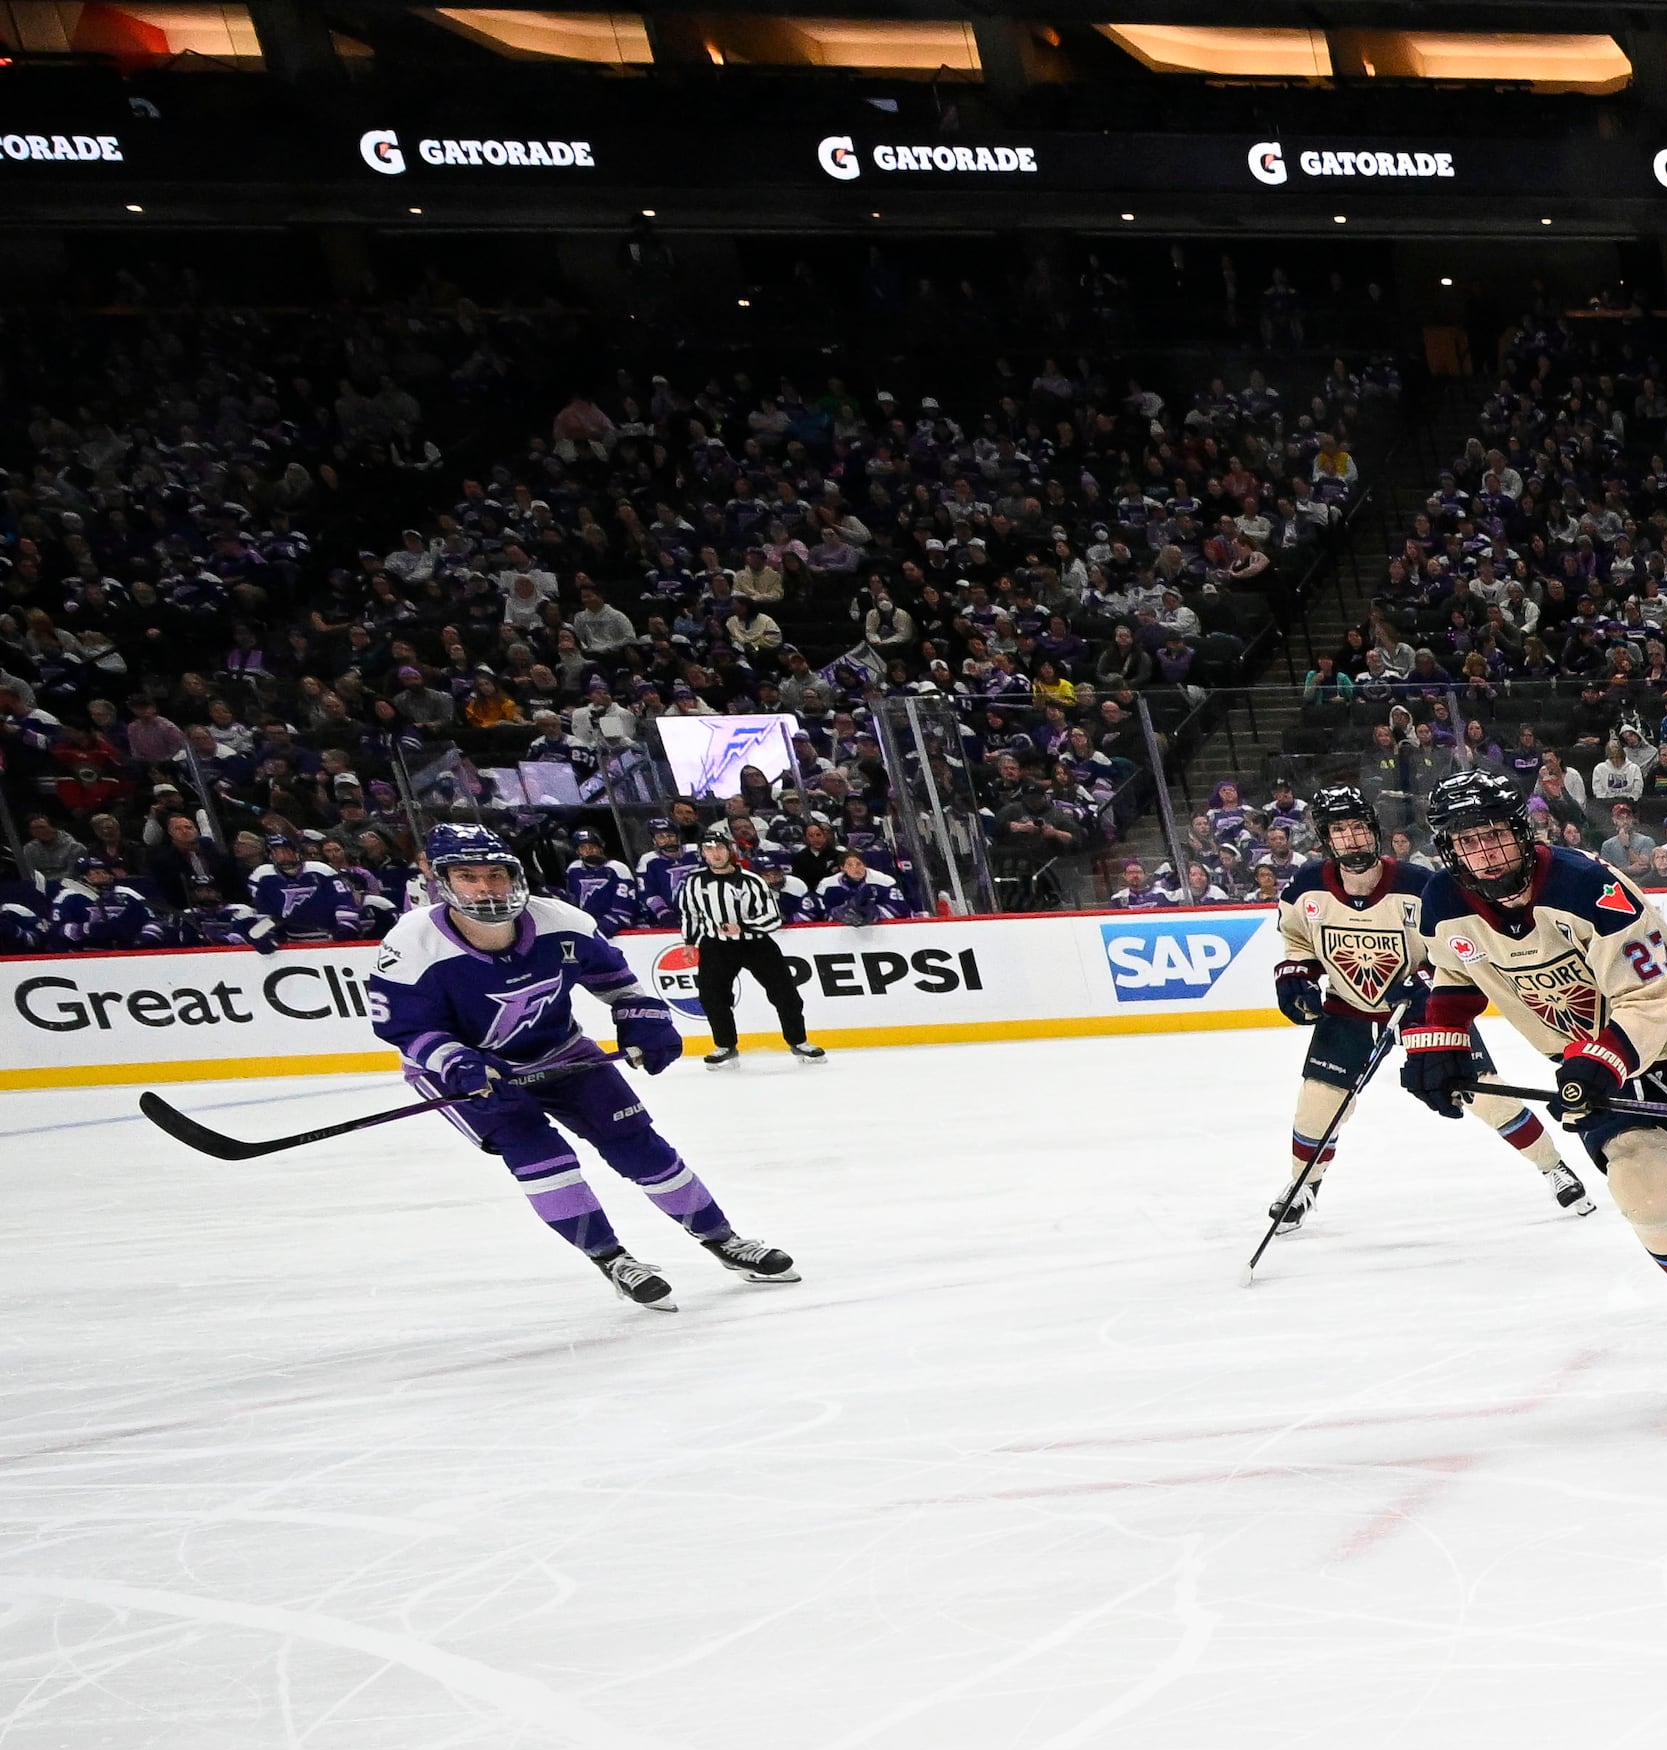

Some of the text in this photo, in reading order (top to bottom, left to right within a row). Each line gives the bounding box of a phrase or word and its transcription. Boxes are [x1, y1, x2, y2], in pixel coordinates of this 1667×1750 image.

[0, 134, 124, 162] ORADE
[418, 139, 595, 167] GATORADE
[873, 144, 1038, 172] GATORADE
[1299, 150, 1455, 177] GATORADE
[783, 947, 984, 999] PEPSI
[1107, 934, 1232, 988] SAP
[14, 974, 253, 1033] Great
